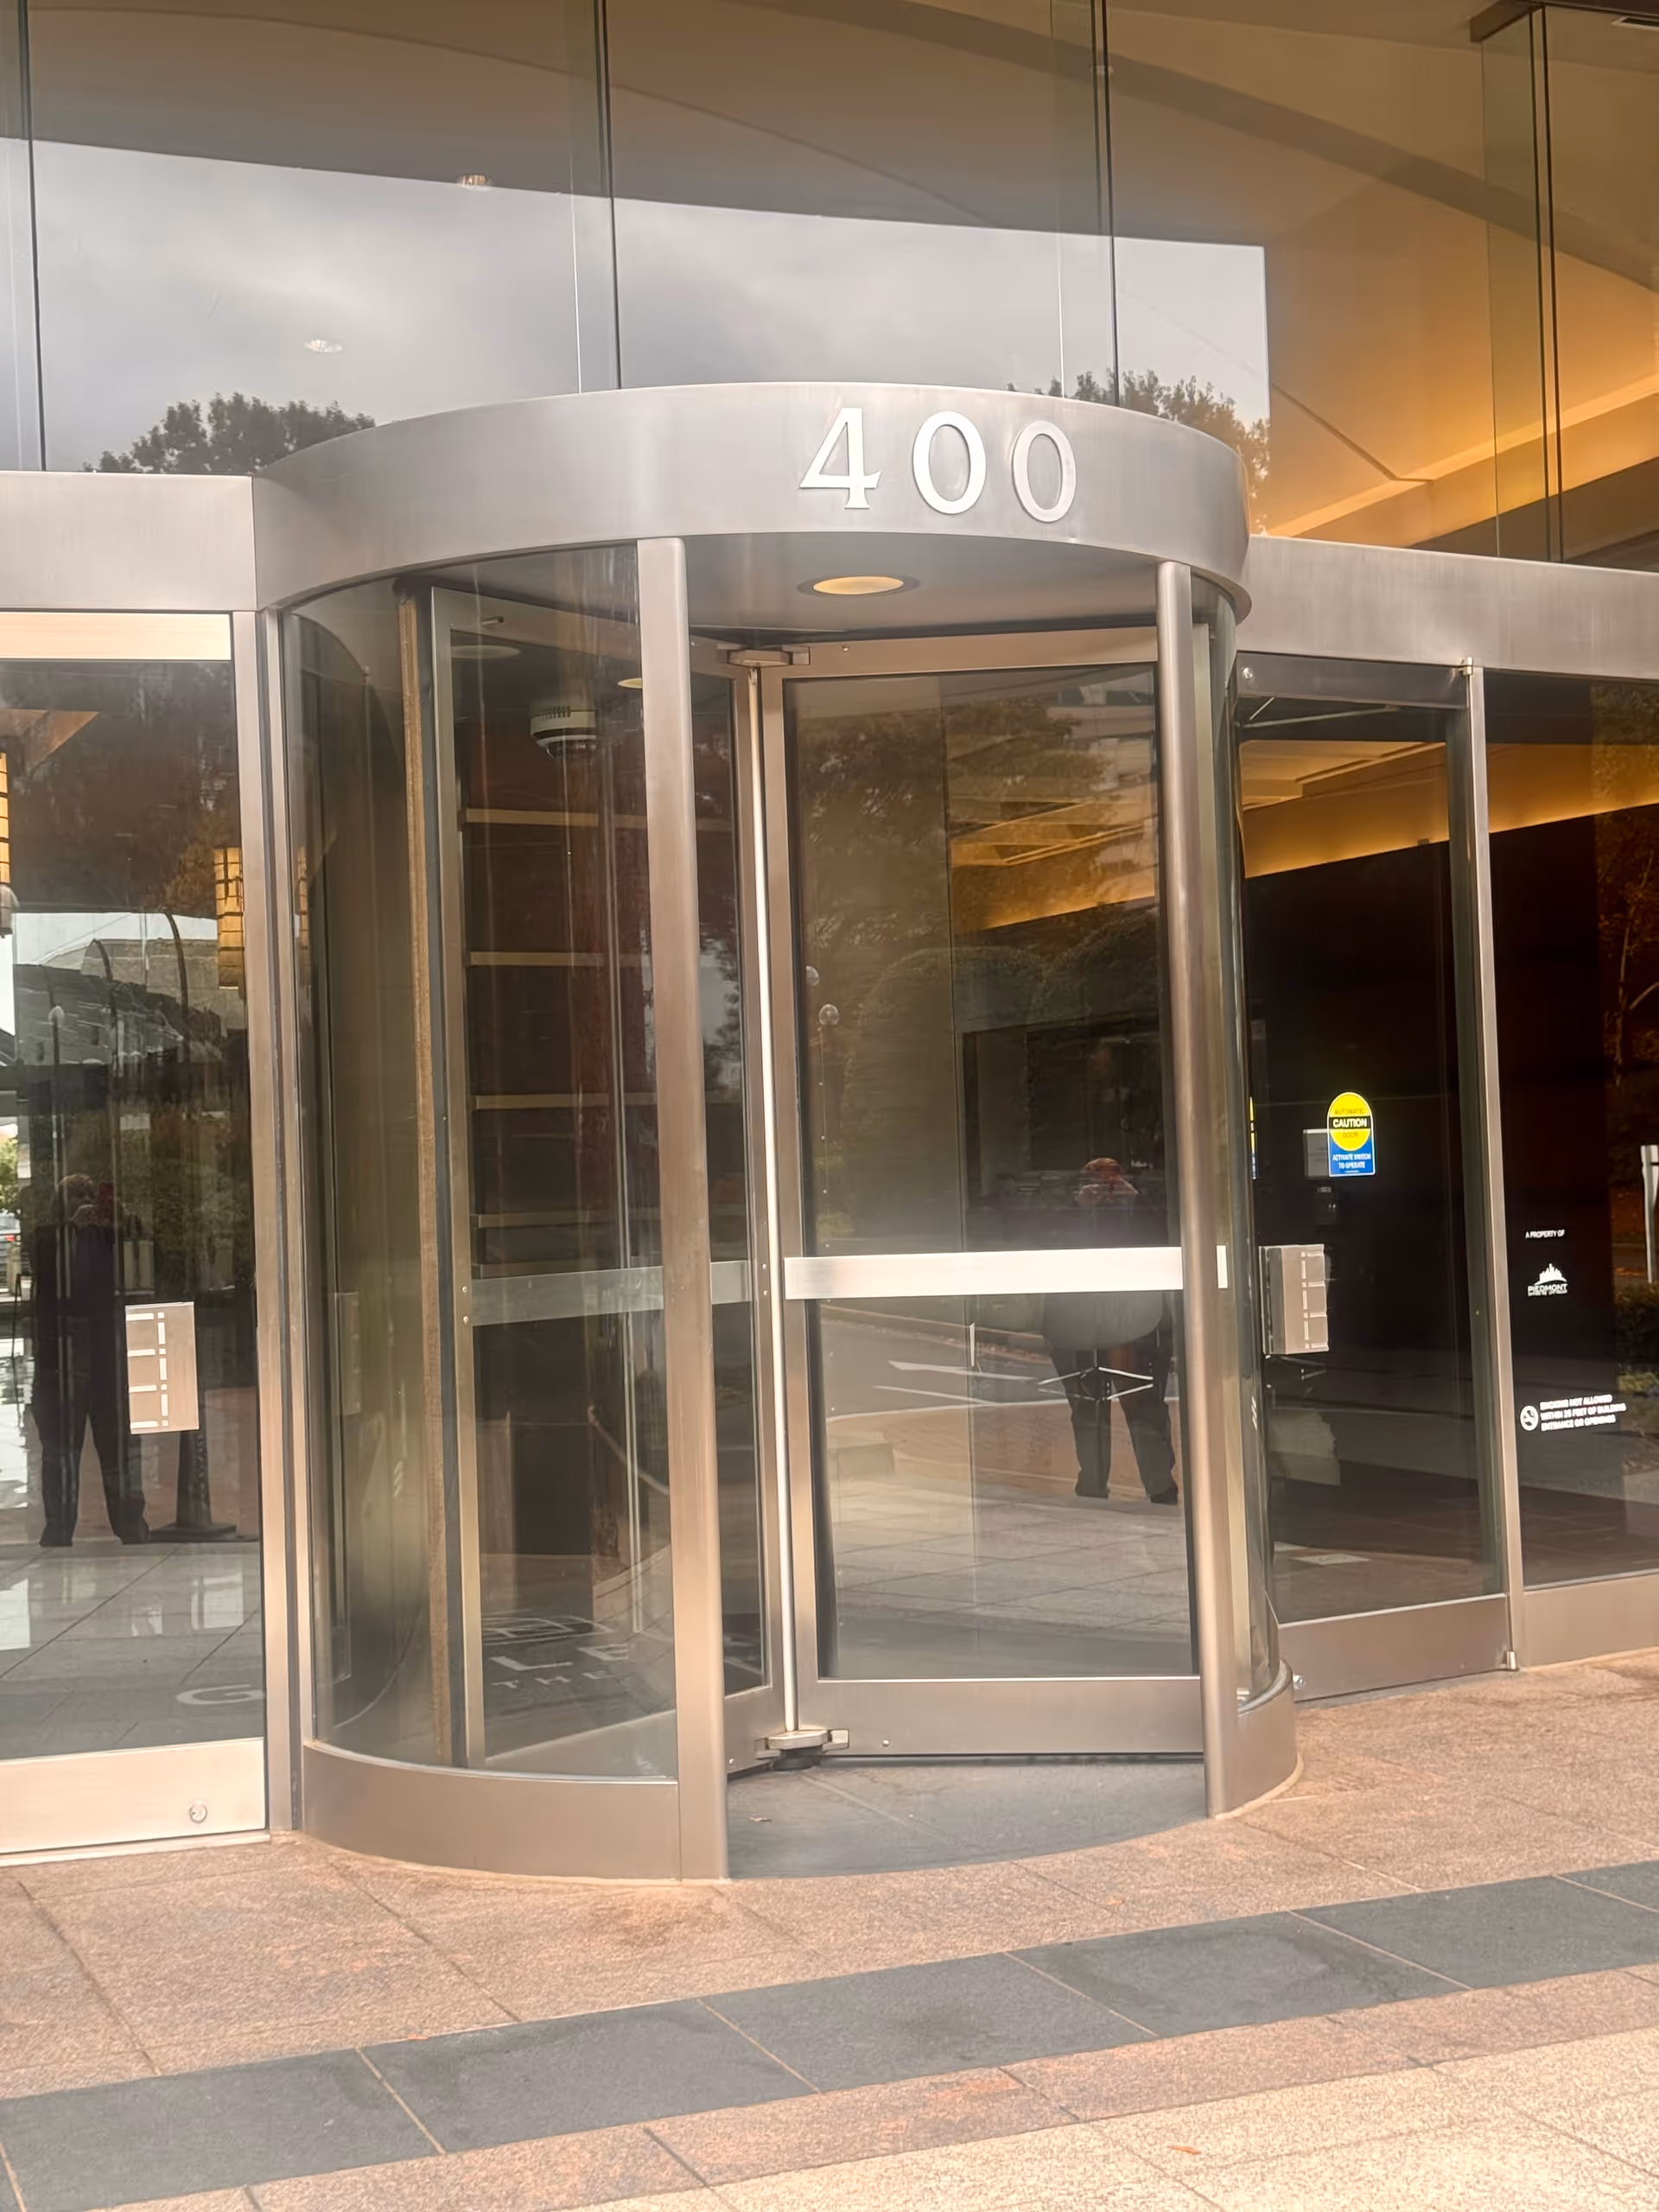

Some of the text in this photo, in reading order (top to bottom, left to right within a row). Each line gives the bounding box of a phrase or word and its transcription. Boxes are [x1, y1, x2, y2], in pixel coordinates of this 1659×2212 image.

[799, 408, 1077, 524] 400
[1332, 1118, 1367, 1128] CAUTION
[1527, 1283, 1567, 1294] PIEDMONT
[1569, 1397, 1583, 1408] NOT
[1583, 1394, 1613, 1406] ALLOWED
[1540, 1410, 1563, 1421] WITHIN
[1573, 1407, 1587, 1417] FEET
[1587, 1406, 1597, 1415] OF
[1541, 1419, 1574, 1432] ENTRANCE
[1574, 1418, 1585, 1427] OR
